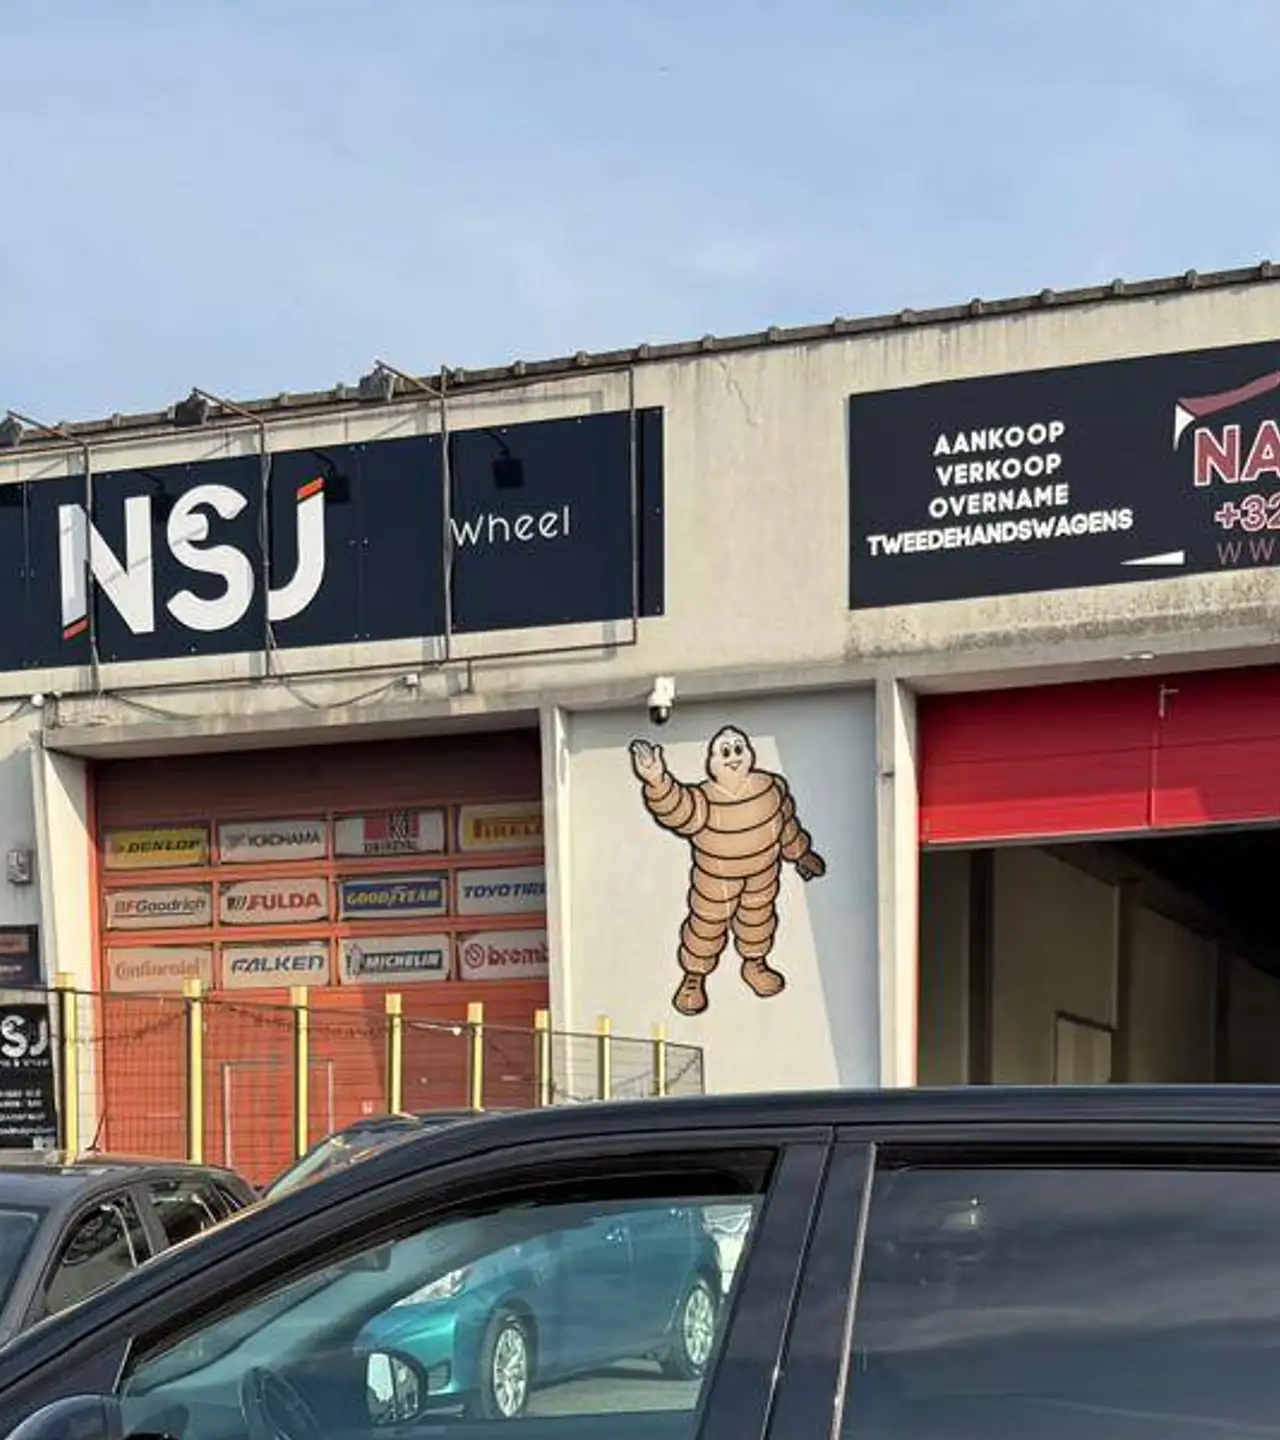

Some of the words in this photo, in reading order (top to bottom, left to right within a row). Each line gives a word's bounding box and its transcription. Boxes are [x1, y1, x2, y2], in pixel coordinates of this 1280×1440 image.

[933, 420, 1065, 456] AANKOOP
[936, 453, 1061, 487] VERKOOP
[929, 484, 1069, 519] OVERNAME
[450, 504, 571, 548] Wheel
[867, 509, 1133, 556] TWEEDEHANDSWAGENS
[58, 475, 326, 640] NSJ
[246, 893, 321, 911] FULDA
[231, 955, 324, 974] FALKEN
